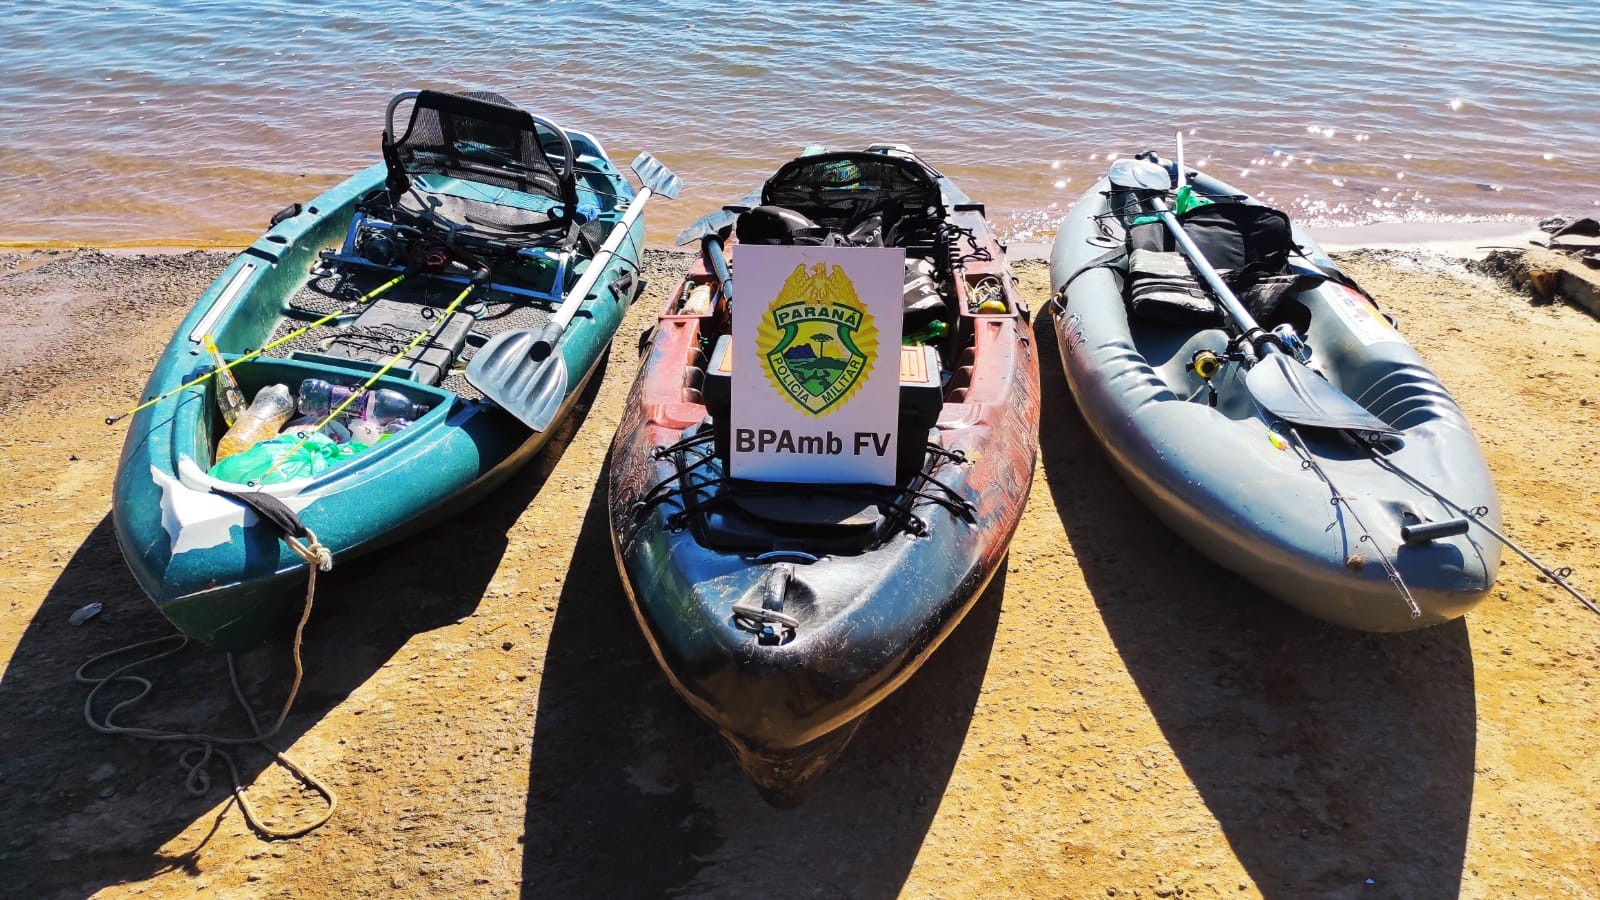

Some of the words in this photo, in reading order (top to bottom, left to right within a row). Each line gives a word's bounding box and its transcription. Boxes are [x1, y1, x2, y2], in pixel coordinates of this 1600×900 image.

[778, 307, 858, 326] PARANÁ
[821, 360, 861, 403] MILITAR
[736, 429, 843, 455] BPAmb
[853, 432, 891, 456] FV
